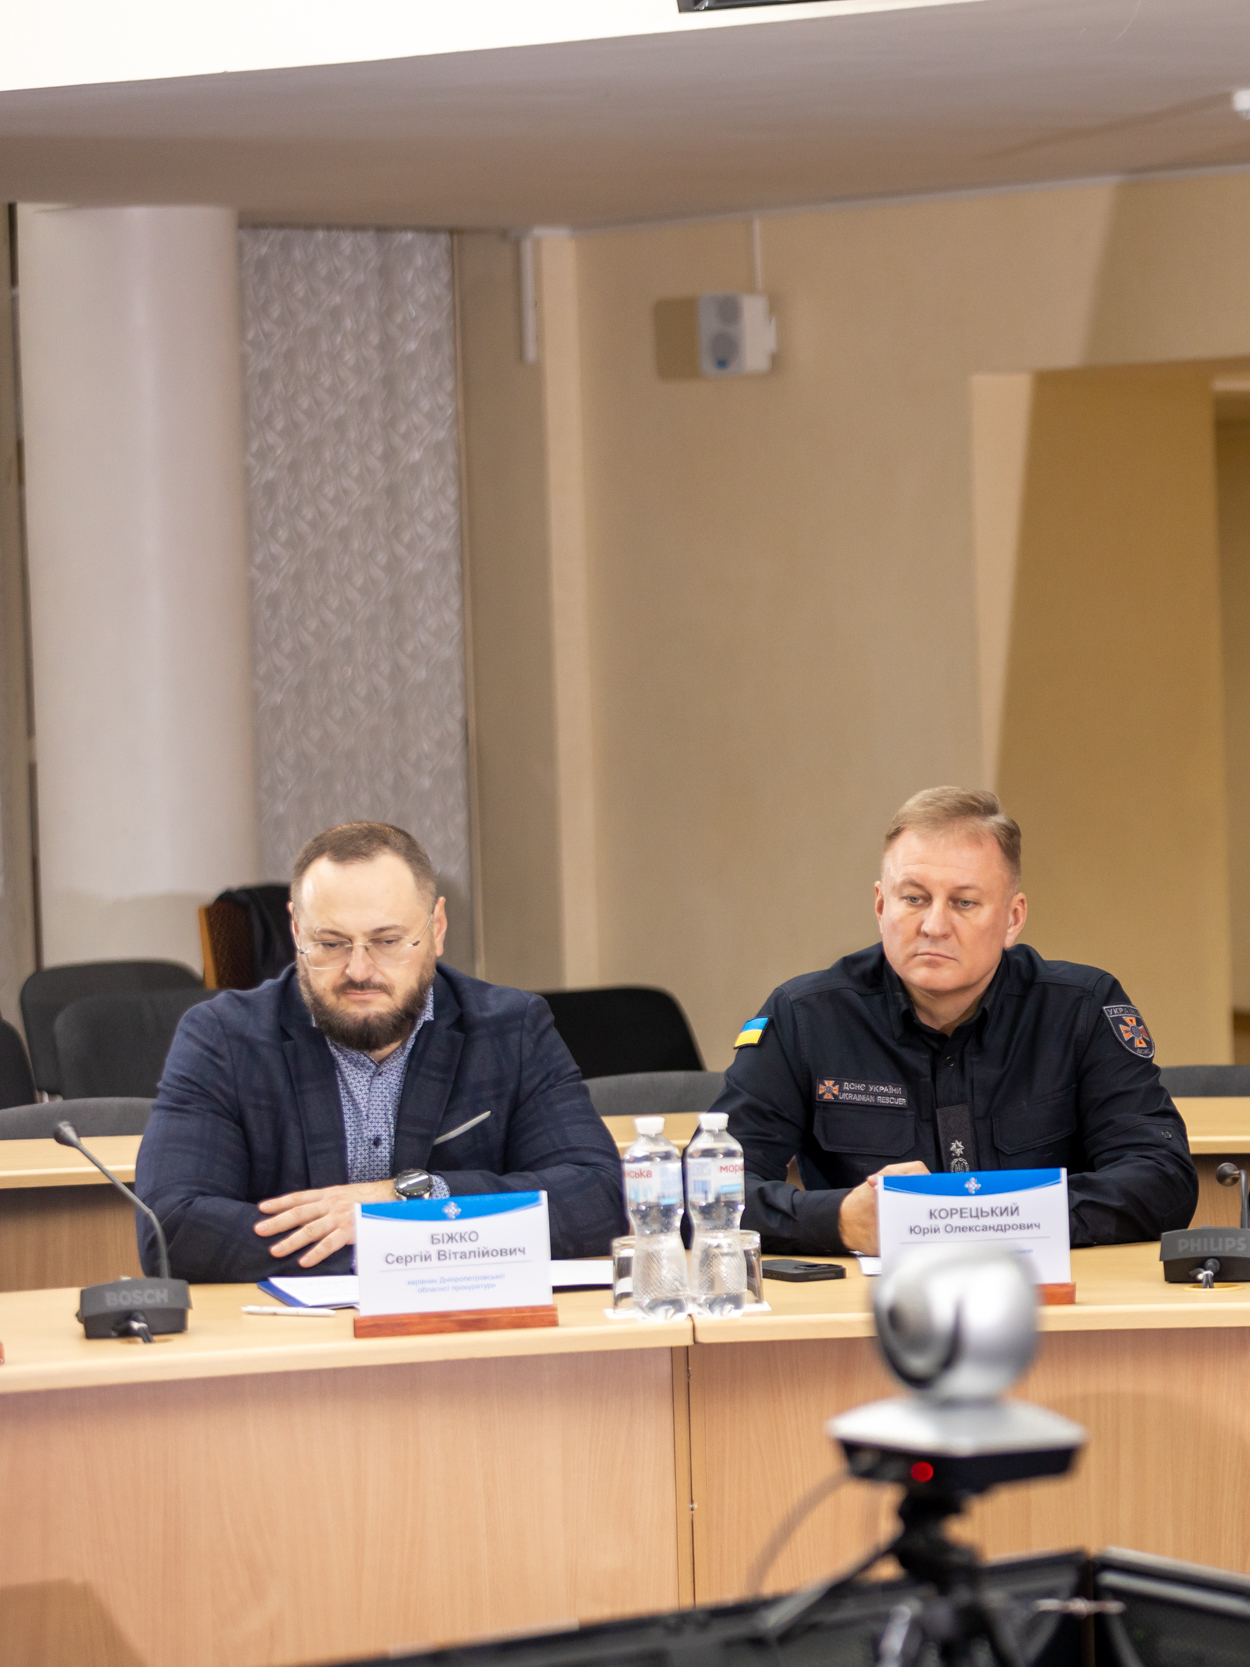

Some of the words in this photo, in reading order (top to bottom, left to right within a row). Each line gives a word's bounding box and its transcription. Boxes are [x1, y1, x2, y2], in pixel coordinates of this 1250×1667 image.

[868, 1084, 902, 1095] УКРАЇНИ
[838, 1092, 875, 1103] UKRAINIAN
[877, 1095, 907, 1105] RESCUER
[929, 1202, 1020, 1220] КОРЕЦЬКИЙ
[909, 1223, 941, 1237] Юрій
[944, 1221, 1041, 1235] Олександрович
[430, 1230, 479, 1246] БІЖКО
[1177, 1237, 1247, 1253] PHILIPS
[385, 1250, 432, 1266] Сергій
[437, 1246, 526, 1262] Віталійович
[104, 1288, 169, 1307] BOSCH
